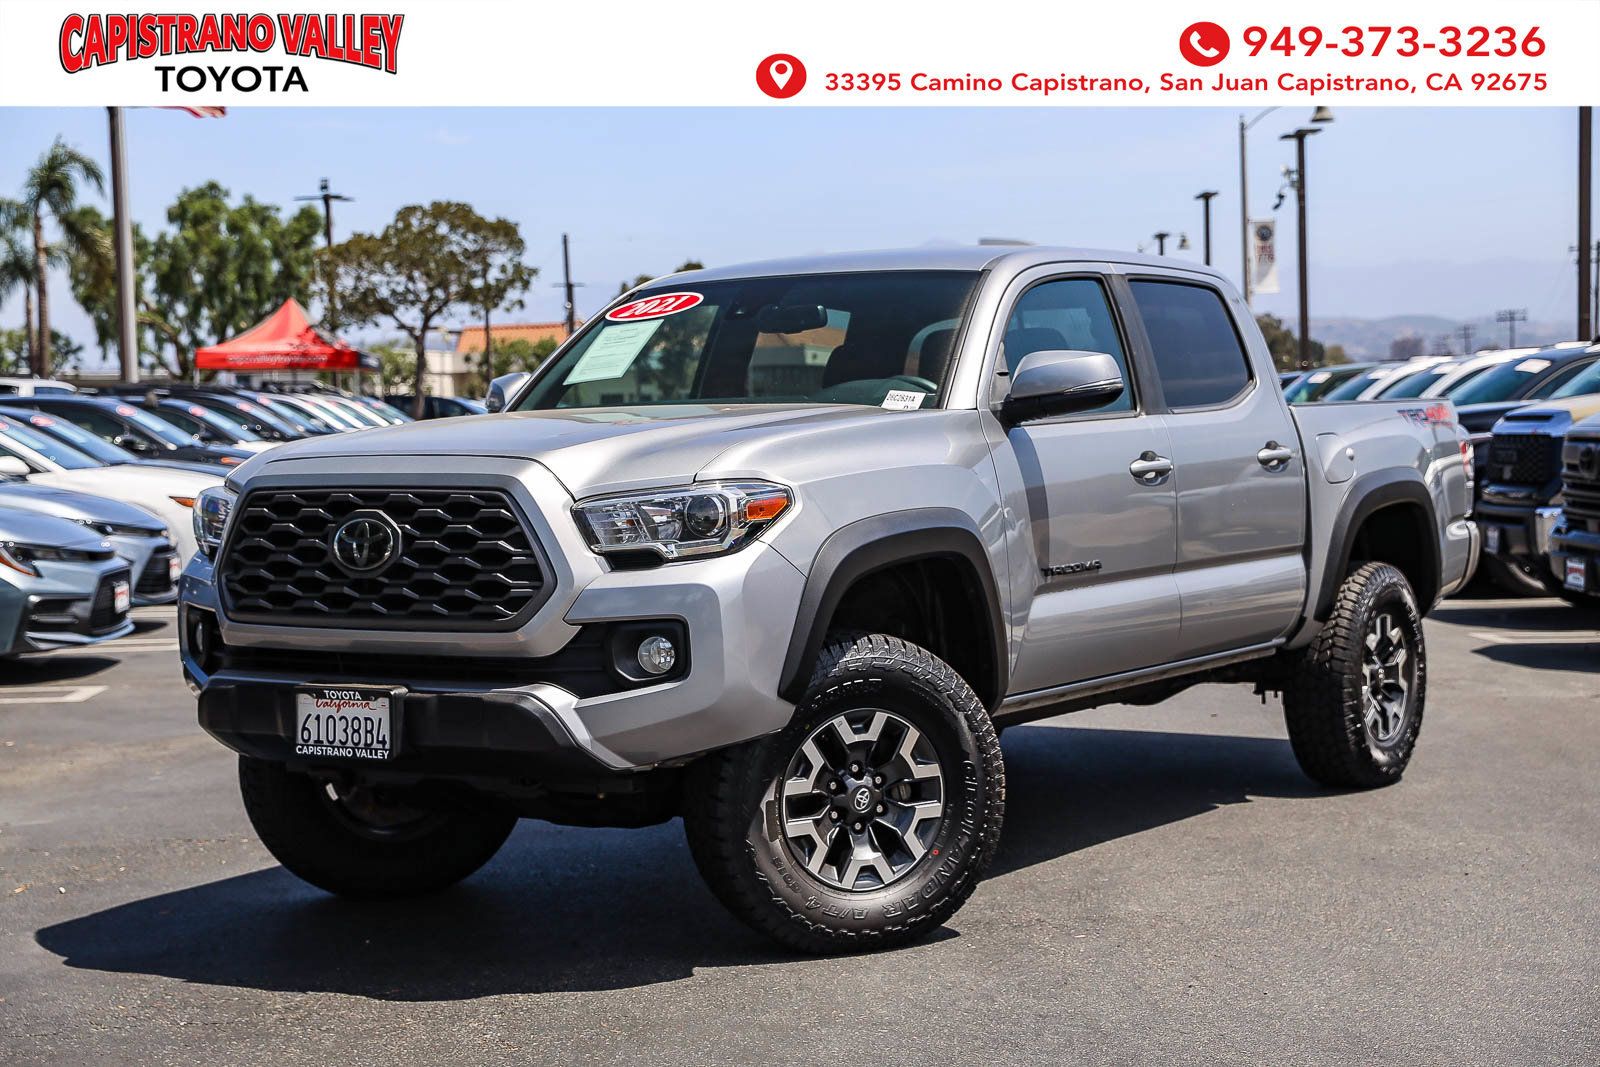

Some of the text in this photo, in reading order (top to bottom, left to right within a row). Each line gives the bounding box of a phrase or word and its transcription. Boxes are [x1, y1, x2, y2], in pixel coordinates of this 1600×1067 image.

[617, 296, 690, 318] 2021
[323, 690, 362, 700] TOYOTA
[316, 698, 377, 713] California
[301, 713, 387, 748] 61038B4
[296, 745, 390, 759] CAPISTRANO VALLEY
